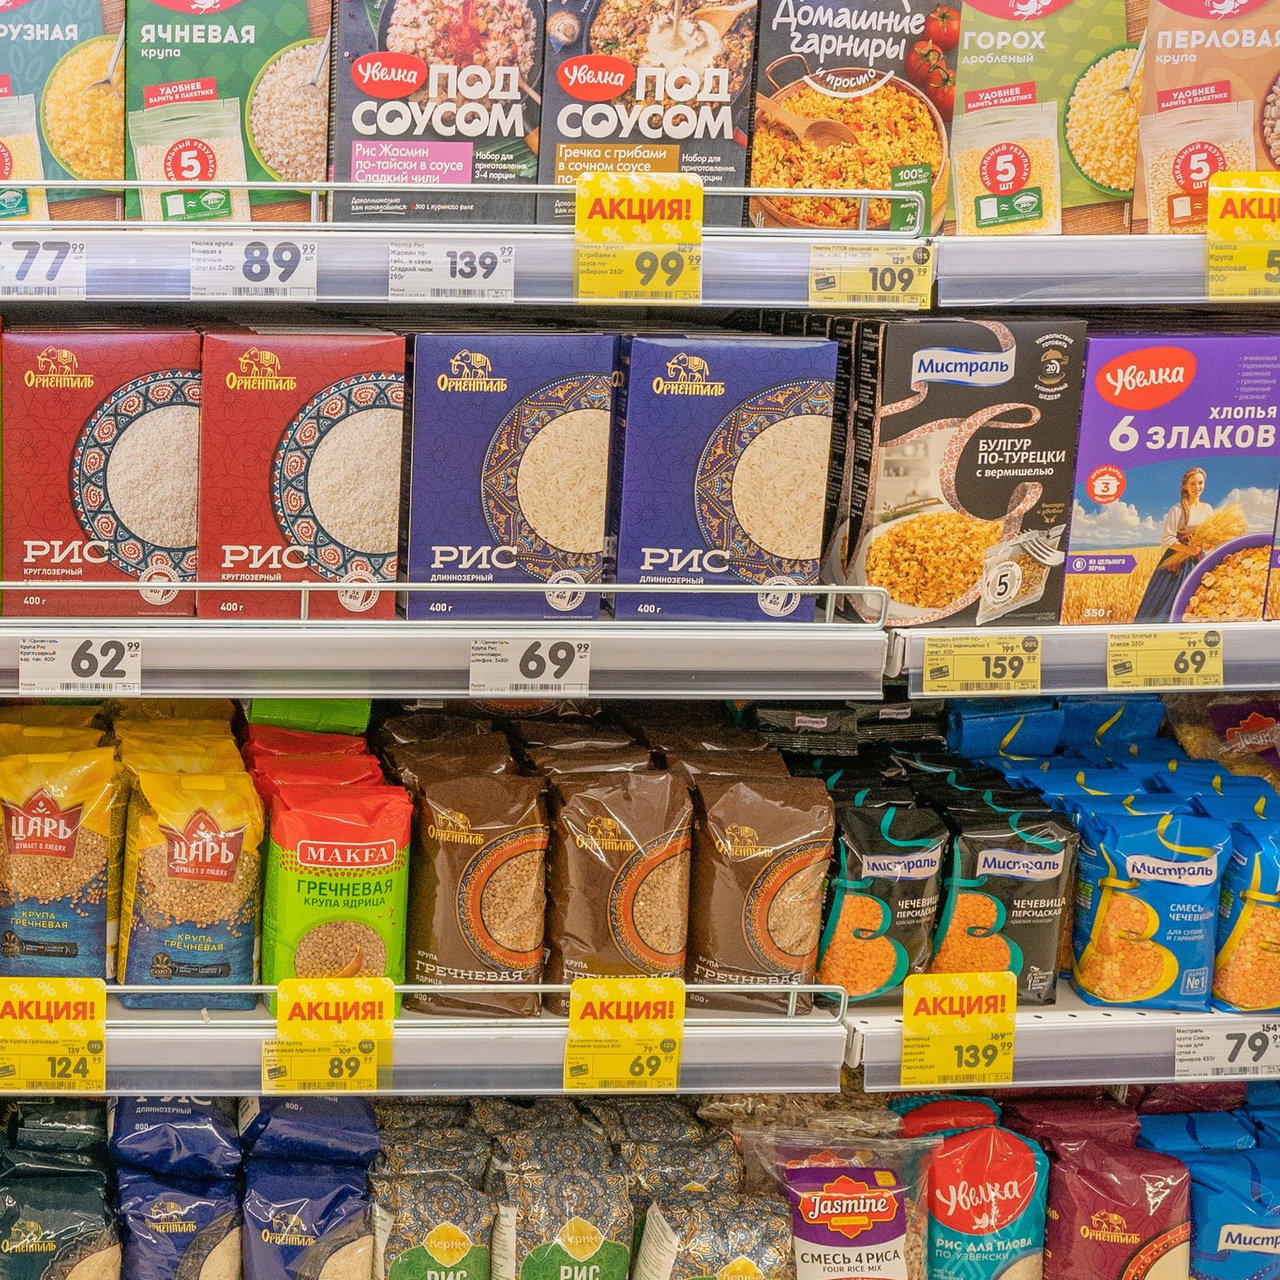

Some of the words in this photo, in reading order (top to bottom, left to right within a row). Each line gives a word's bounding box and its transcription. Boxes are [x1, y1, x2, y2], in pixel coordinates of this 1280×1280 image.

[140, 24, 255, 44] ЯЧНЕВАЯ
[963, 31, 1046, 50] ГОРОХ
[789, 33, 906, 64] гарниры
[962, 52, 1034, 65] дробленый
[429, 65, 521, 100] ПОД
[352, 102, 525, 138] СОУСОМ
[587, 198, 691, 223] АКЦИЯ!
[11, 241, 71, 282] 77
[242, 241, 302, 284] 89
[445, 250, 499, 280] 139
[634, 253, 685, 286] 99
[868, 268, 914, 293] 109
[917, 358, 1009, 374] Мистраль
[1106, 363, 1185, 395] Увелка
[979, 438, 1032, 452] БУЛГУР
[1109, 416, 1139, 451] 6
[1146, 424, 1276, 449] ЗЛАКОВ
[978, 450, 1066, 465] ПО-ТУРЕЦКИ
[984, 466, 1054, 478] вермишелью
[431, 545, 518, 569] РИС
[23, 567, 83, 576] КРУГЛОЗЕРНЫЙ
[430, 572, 493, 582] ДЛИННОЗЕРНЫЙ
[70, 640, 126, 678] 62
[519, 641, 576, 679] 69
[981, 655, 1023, 679] 159
[1173, 650, 1206, 674] 69
[11, 816, 72, 840] ЦАРЬ
[306, 847, 389, 863] MAKFA
[982, 855, 1059, 872] Мистраль
[297, 879, 393, 896] ГРЕЧНЕВАЯ
[343, 897, 386, 907] ЯДРИЦА
[47, 1057, 89, 1078] 124
[327, 1057, 361, 1077] 89
[954, 1044, 999, 1068] 139
[809, 1195, 890, 1217] Jasmine
[801, 1251, 852, 1265] СМЕСЬ
[854, 1251, 862, 1264] 4
[865, 1249, 901, 1264] РИСА
